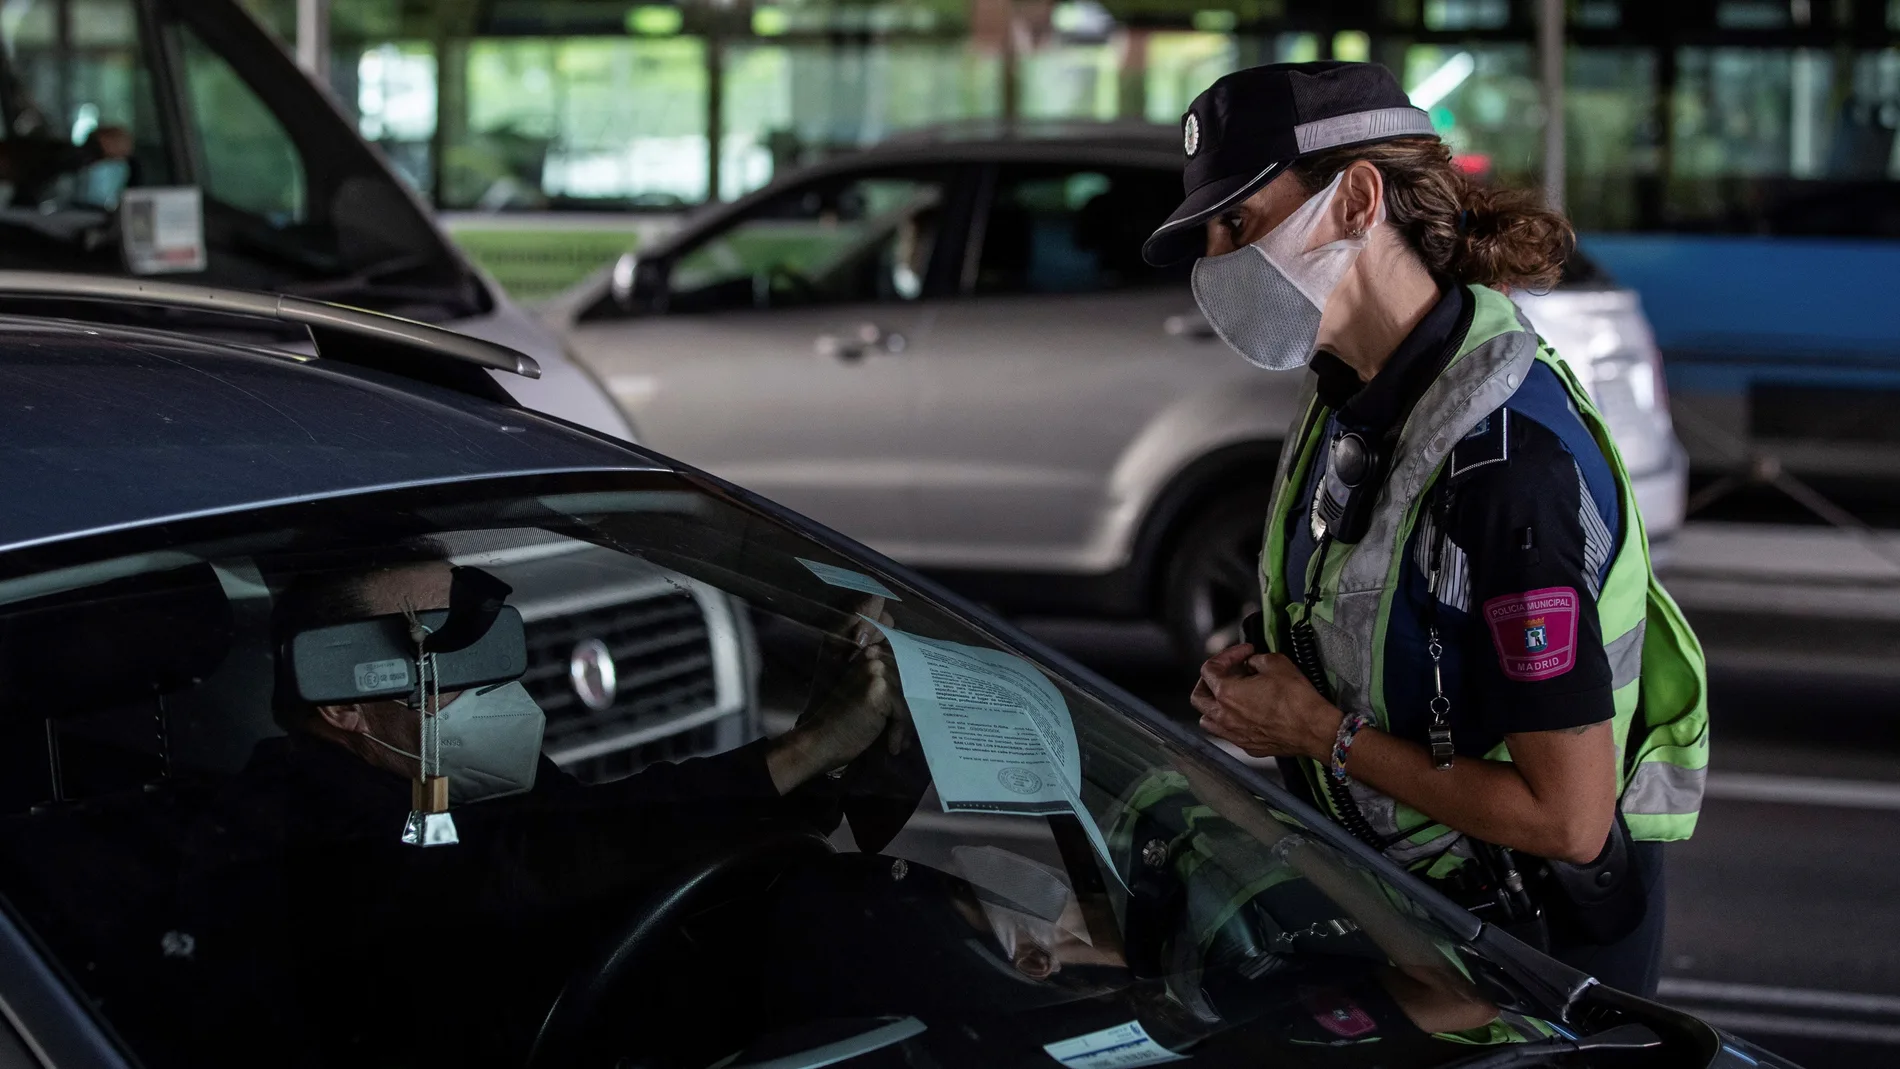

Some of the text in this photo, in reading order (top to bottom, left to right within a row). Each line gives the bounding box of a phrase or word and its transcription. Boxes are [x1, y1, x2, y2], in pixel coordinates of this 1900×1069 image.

[1492, 598, 1570, 617] POLICIA MUNICIPAL
[1517, 657, 1559, 671] MADRID
